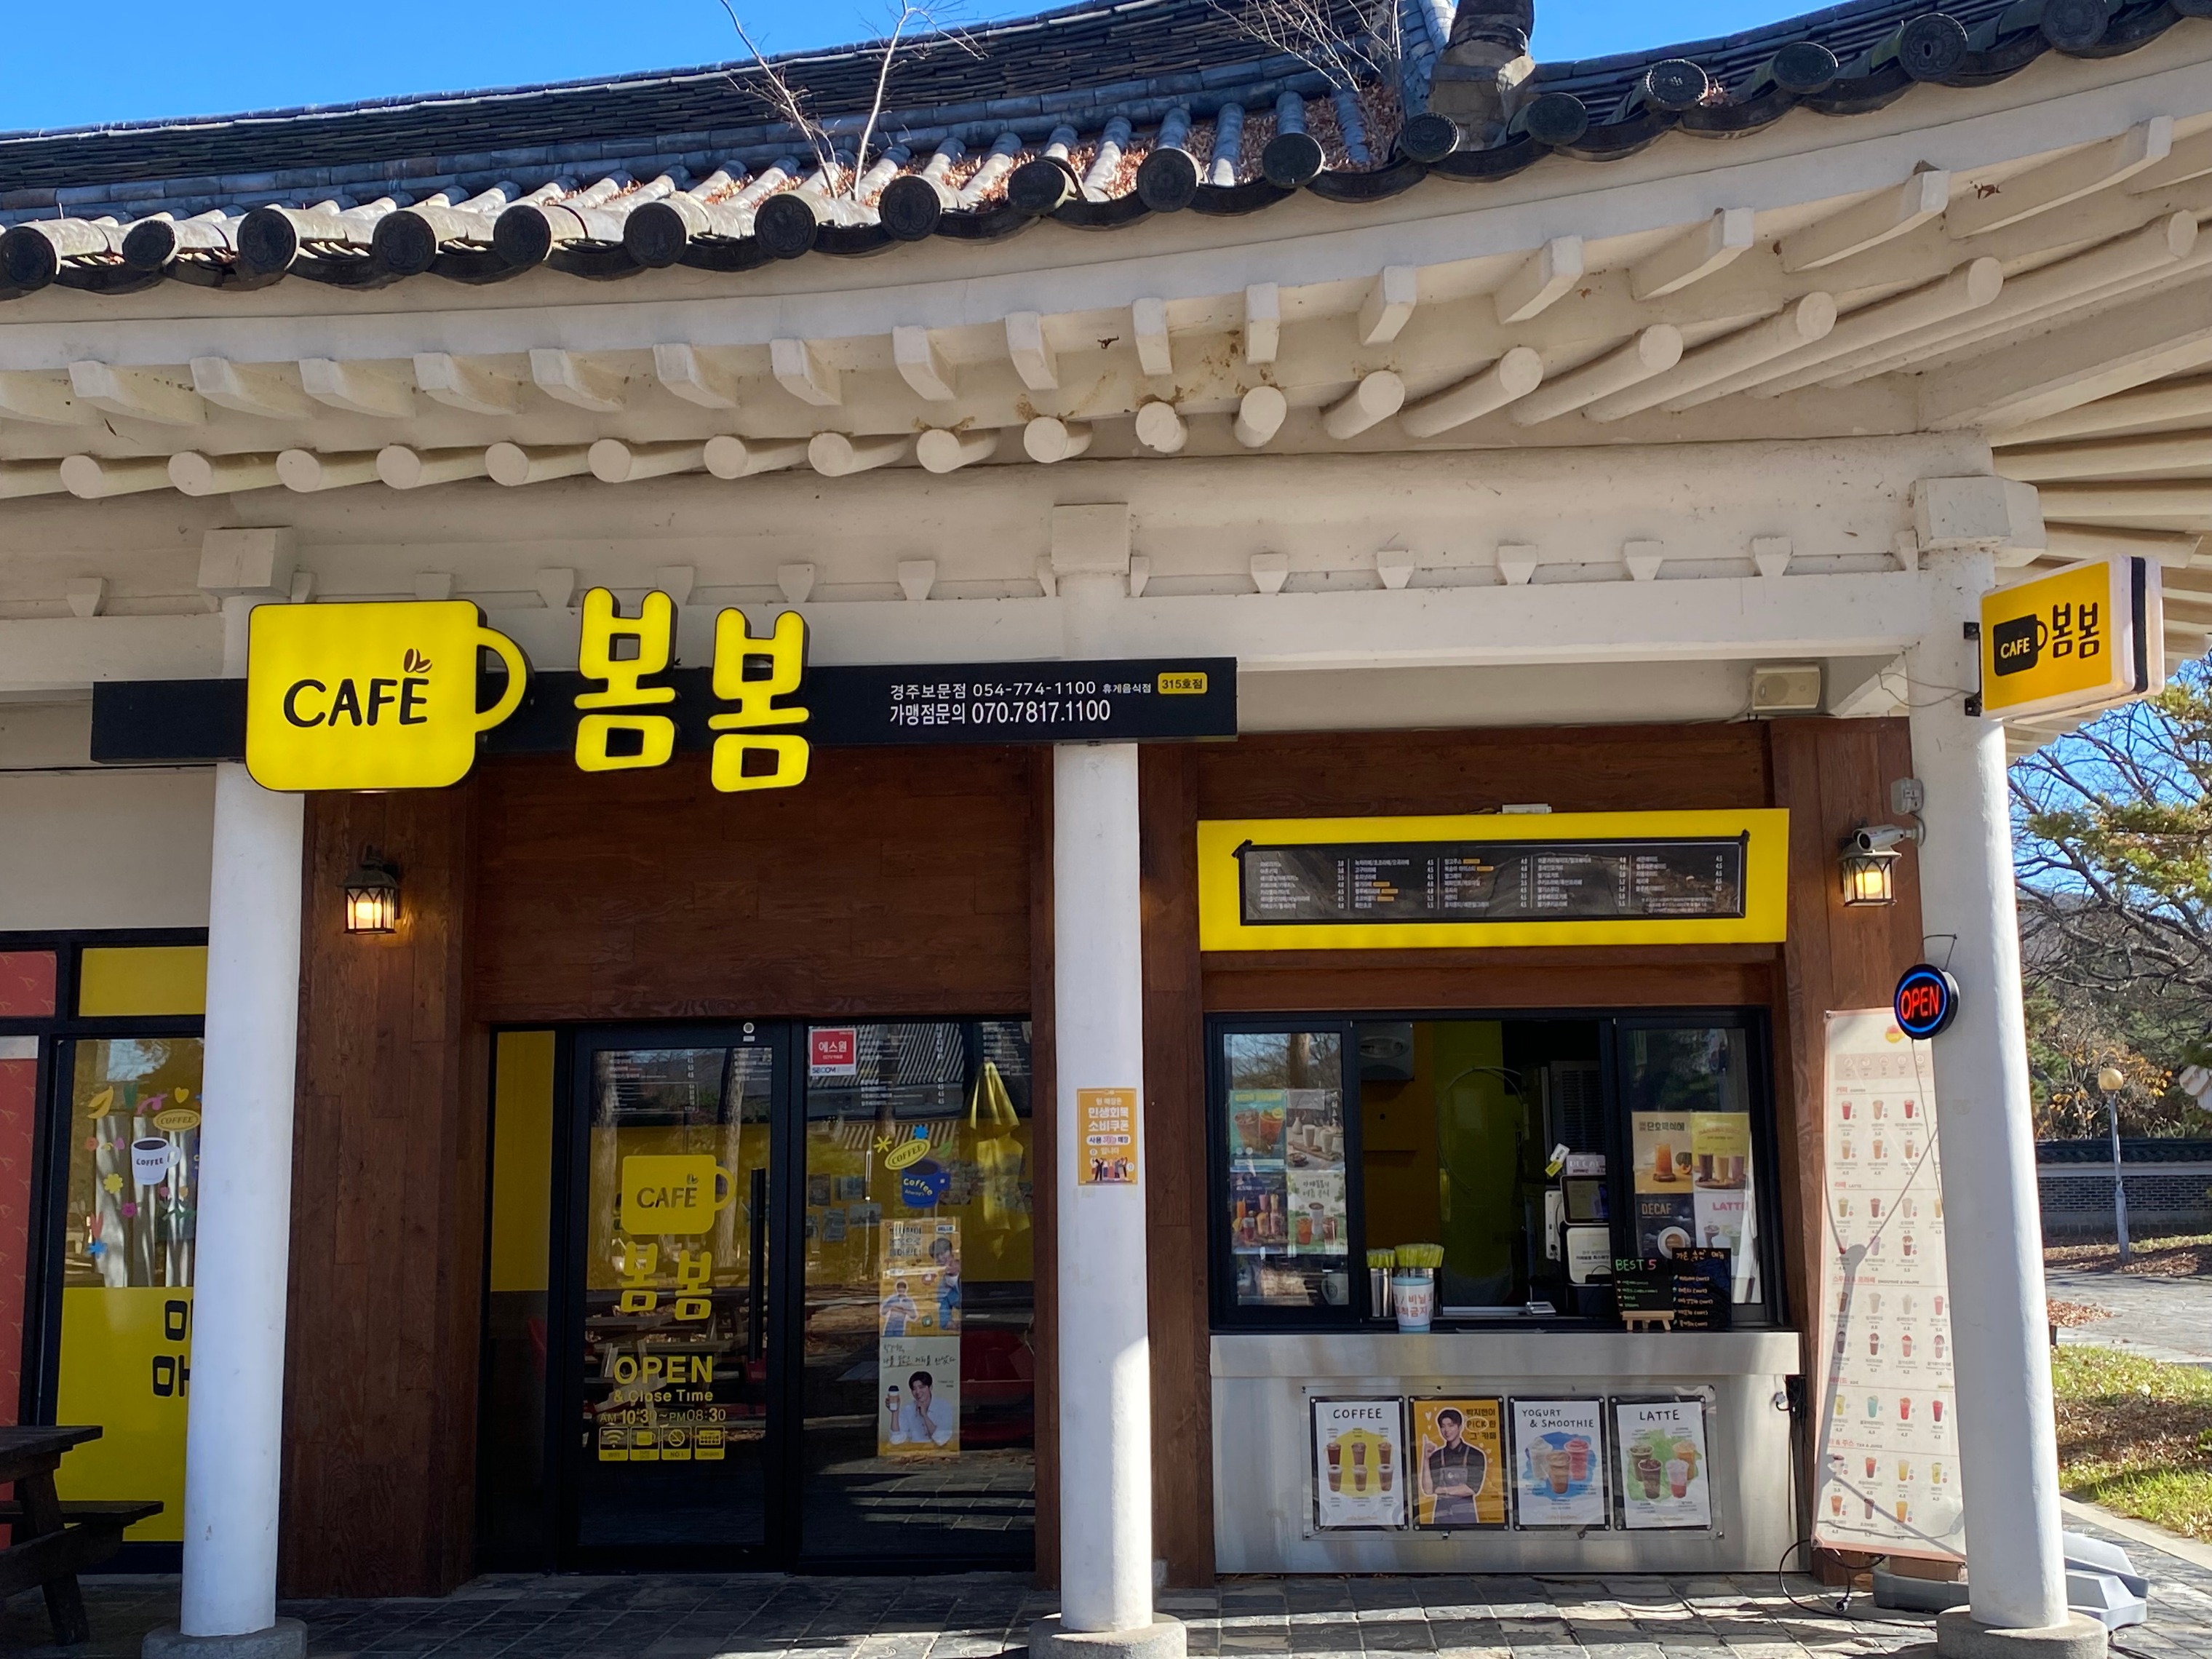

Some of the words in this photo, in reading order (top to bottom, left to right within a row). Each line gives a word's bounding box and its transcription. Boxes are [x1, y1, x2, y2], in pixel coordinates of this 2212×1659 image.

[2052, 602, 2100, 659] 봄봄
[2000, 637, 2031, 659] CAFE
[890, 683, 967, 700] 경주보문점
[973, 680, 1097, 697] 054-774-1100
[1102, 683, 1152, 694] 휴게음식점
[1161, 678, 1204, 691] 315호점
[284, 679, 429, 727] CAFE
[890, 702, 966, 725] 가맹점문의
[972, 699, 1111, 723] 070.7817.1100
[1901, 984, 1940, 1020] OPEN
[819, 1041, 847, 1053] 에스원
[1088, 1107, 1129, 1118] 민생회복
[161, 1116, 194, 1125] COFFEE
[1089, 1120, 1129, 1131] 소비쿠폰
[1089, 1136, 1102, 1144] 사용
[891, 1143, 924, 1165] COFFEE
[136, 1158, 164, 1167] COFFEE
[903, 1177, 934, 1196] Coffee
[637, 1187, 697, 1209] CAFE
[1642, 1203, 1671, 1215] DECAF
[1615, 1259, 1644, 1271] BEST
[1647, 1259, 1658, 1270] 5
[1409, 1294, 1426, 1305] 비닐
[613, 1356, 713, 1385] OPEN
[613, 1391, 624, 1402] &
[628, 1390, 672, 1402] Close
[676, 1389, 713, 1401] Time
[1333, 1408, 1382, 1419] COFFEE
[1522, 1409, 1561, 1417] YOGURT
[1640, 1409, 1680, 1421] LATTE
[1529, 1420, 1537, 1428] &
[1542, 1420, 1594, 1428] SMOOTHIE
